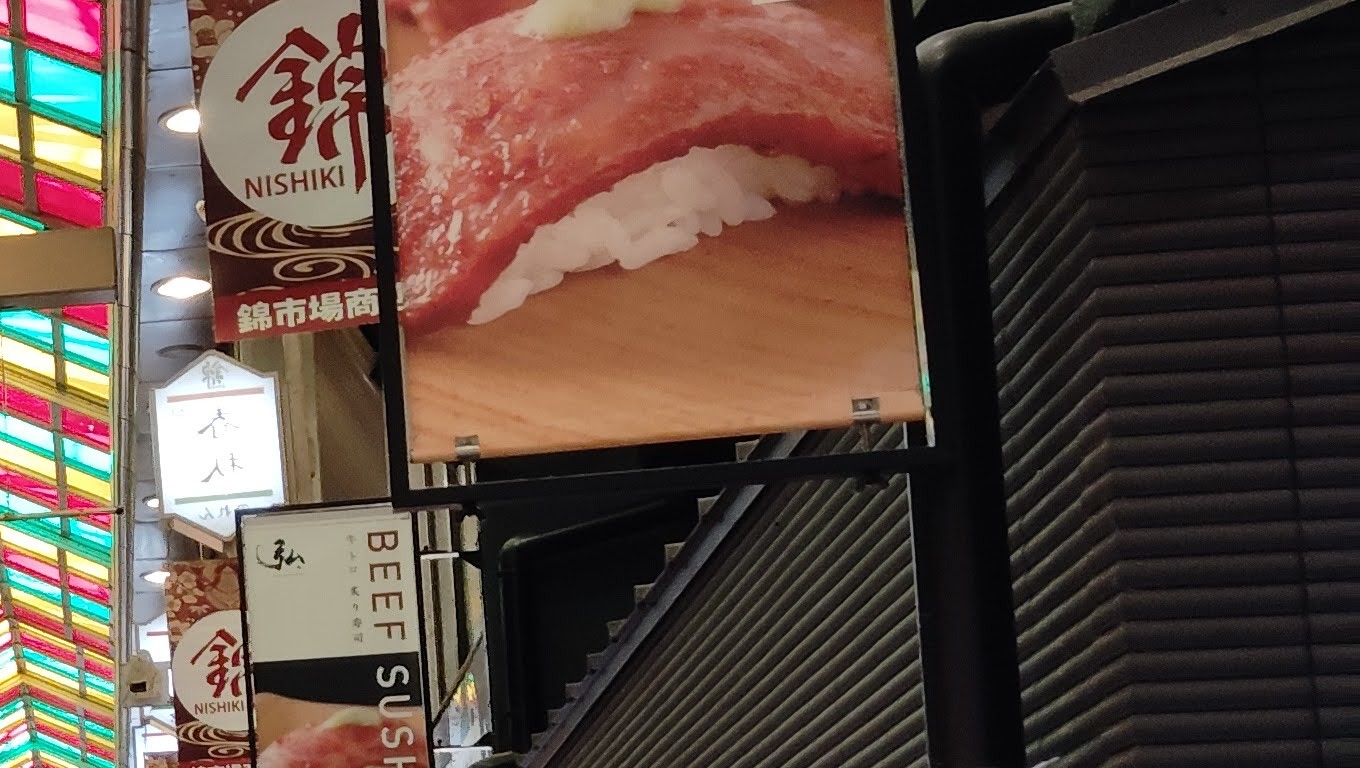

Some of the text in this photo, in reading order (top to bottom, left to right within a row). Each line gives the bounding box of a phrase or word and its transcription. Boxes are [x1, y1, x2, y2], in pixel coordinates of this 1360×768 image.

[245, 165, 345, 199] NISHIKI
[236, 287, 390, 334] 錦市場商
[367, 530, 407, 640] BEEF
[194, 700, 245, 715] NISHIKI
